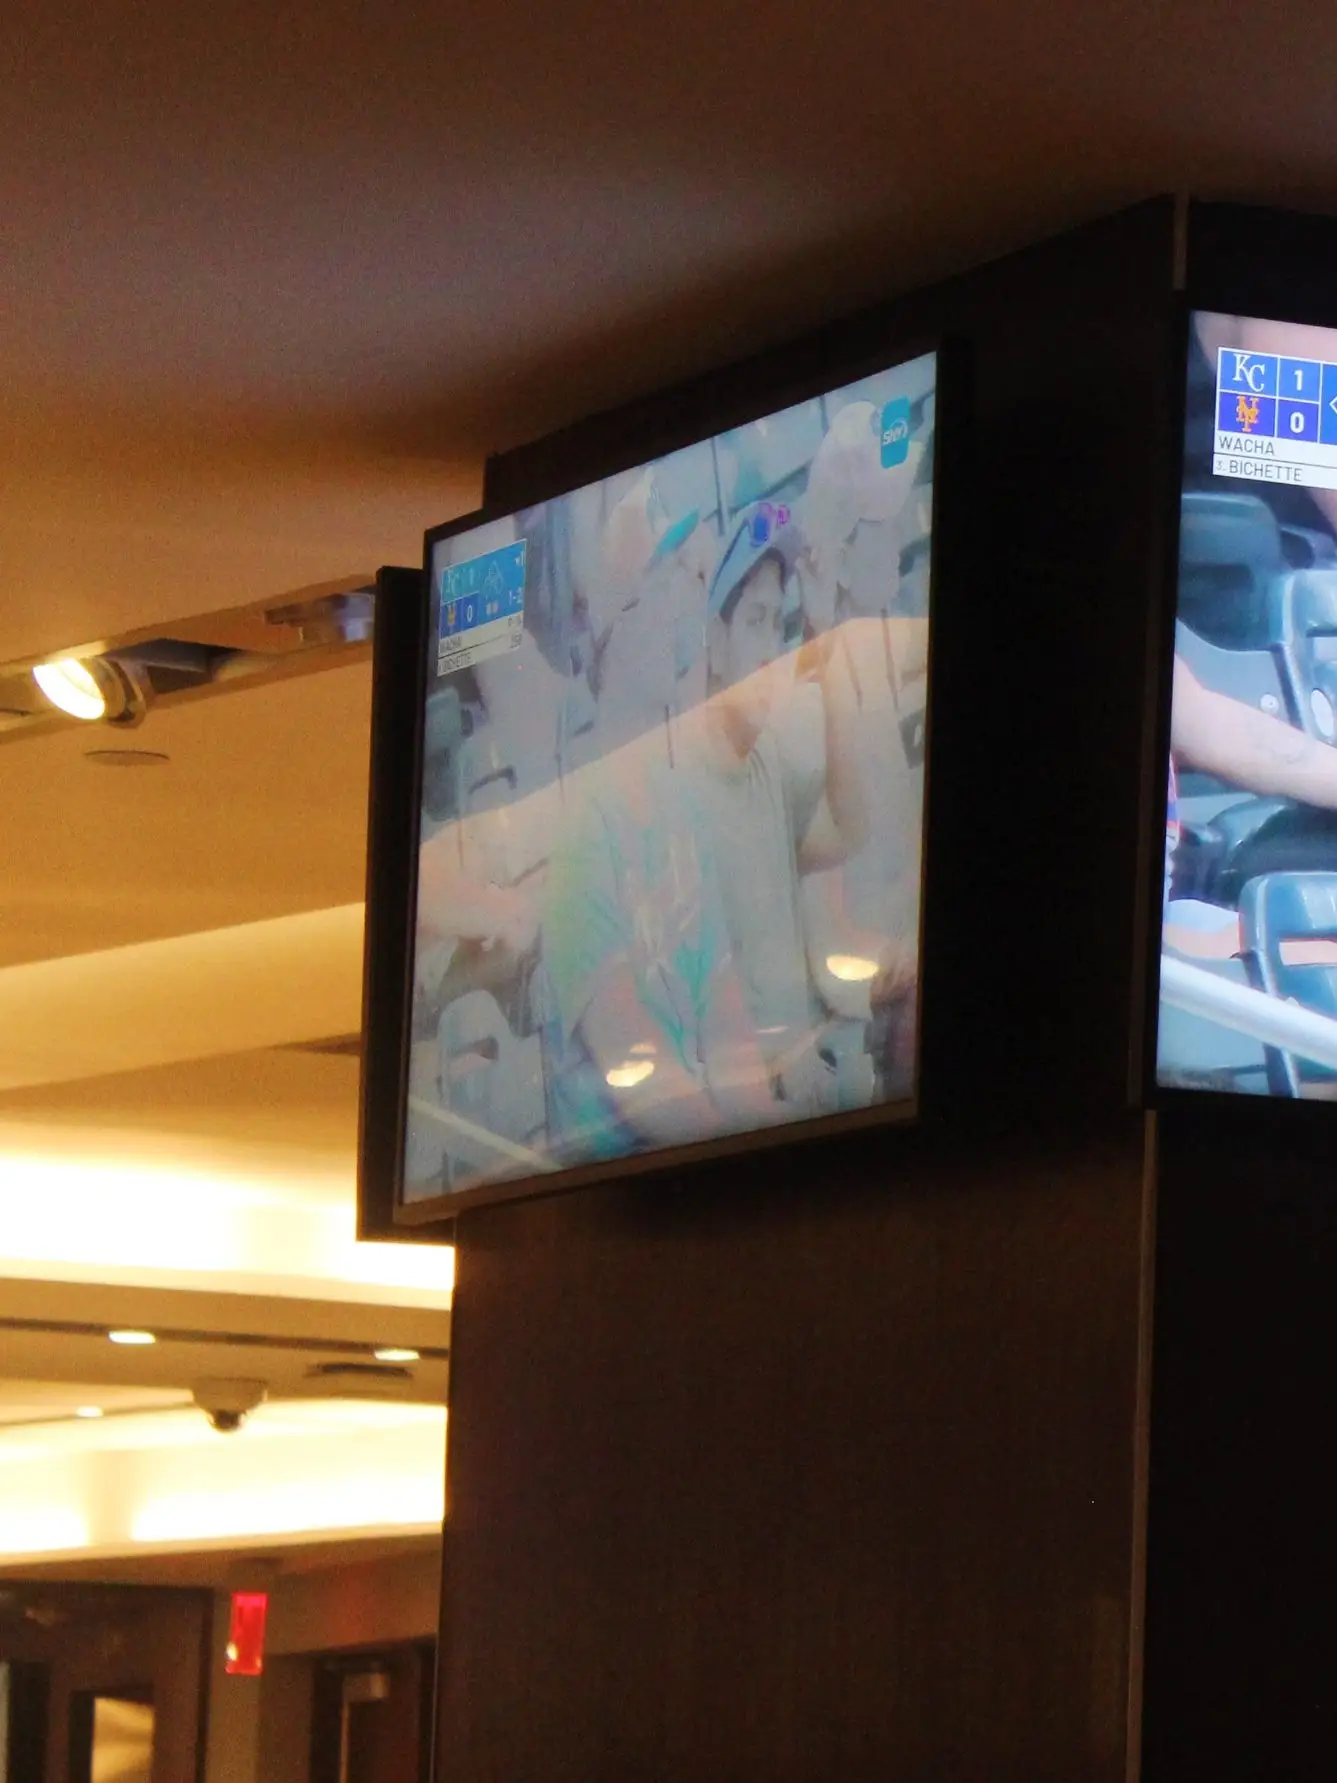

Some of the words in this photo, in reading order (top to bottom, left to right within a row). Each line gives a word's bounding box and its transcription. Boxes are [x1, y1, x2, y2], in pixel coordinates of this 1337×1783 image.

[1232, 353, 1266, 392] KC
[1293, 369, 1304, 392] 1
[1289, 411, 1305, 434] 0
[1218, 435, 1275, 456] WACHA
[1229, 460, 1303, 482] BICHETTE
